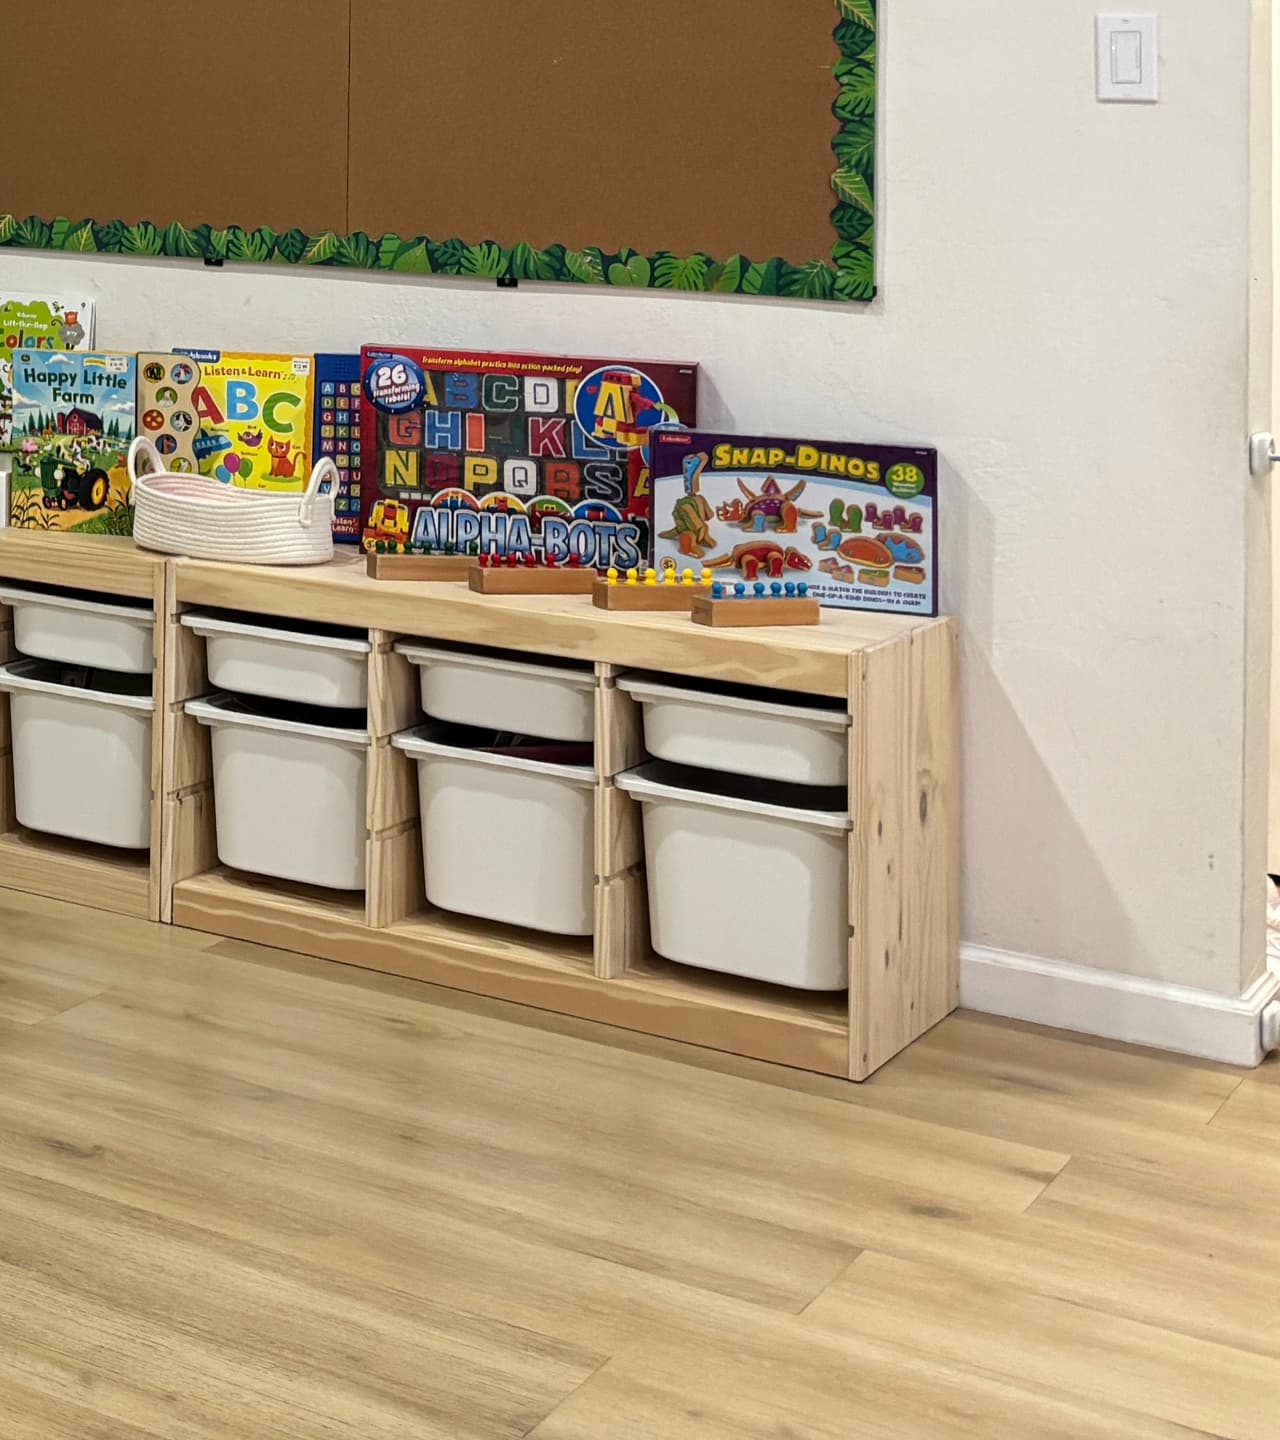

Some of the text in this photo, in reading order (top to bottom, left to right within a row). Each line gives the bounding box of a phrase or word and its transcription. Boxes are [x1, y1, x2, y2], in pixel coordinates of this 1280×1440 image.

[204, 365, 240, 376] Listen
[248, 366, 281, 380] Learn
[422, 356, 452, 365] Transform
[453, 358, 481, 368] alphabet
[482, 361, 507, 370] practice
[24, 367, 127, 389] Happy Little
[377, 364, 407, 387] 26
[52, 387, 95, 404] Farm
[713, 443, 880, 481] SNAP-DINOS
[892, 465, 917, 482] 38
[412, 507, 641, 571] ALPHA-BOTS
